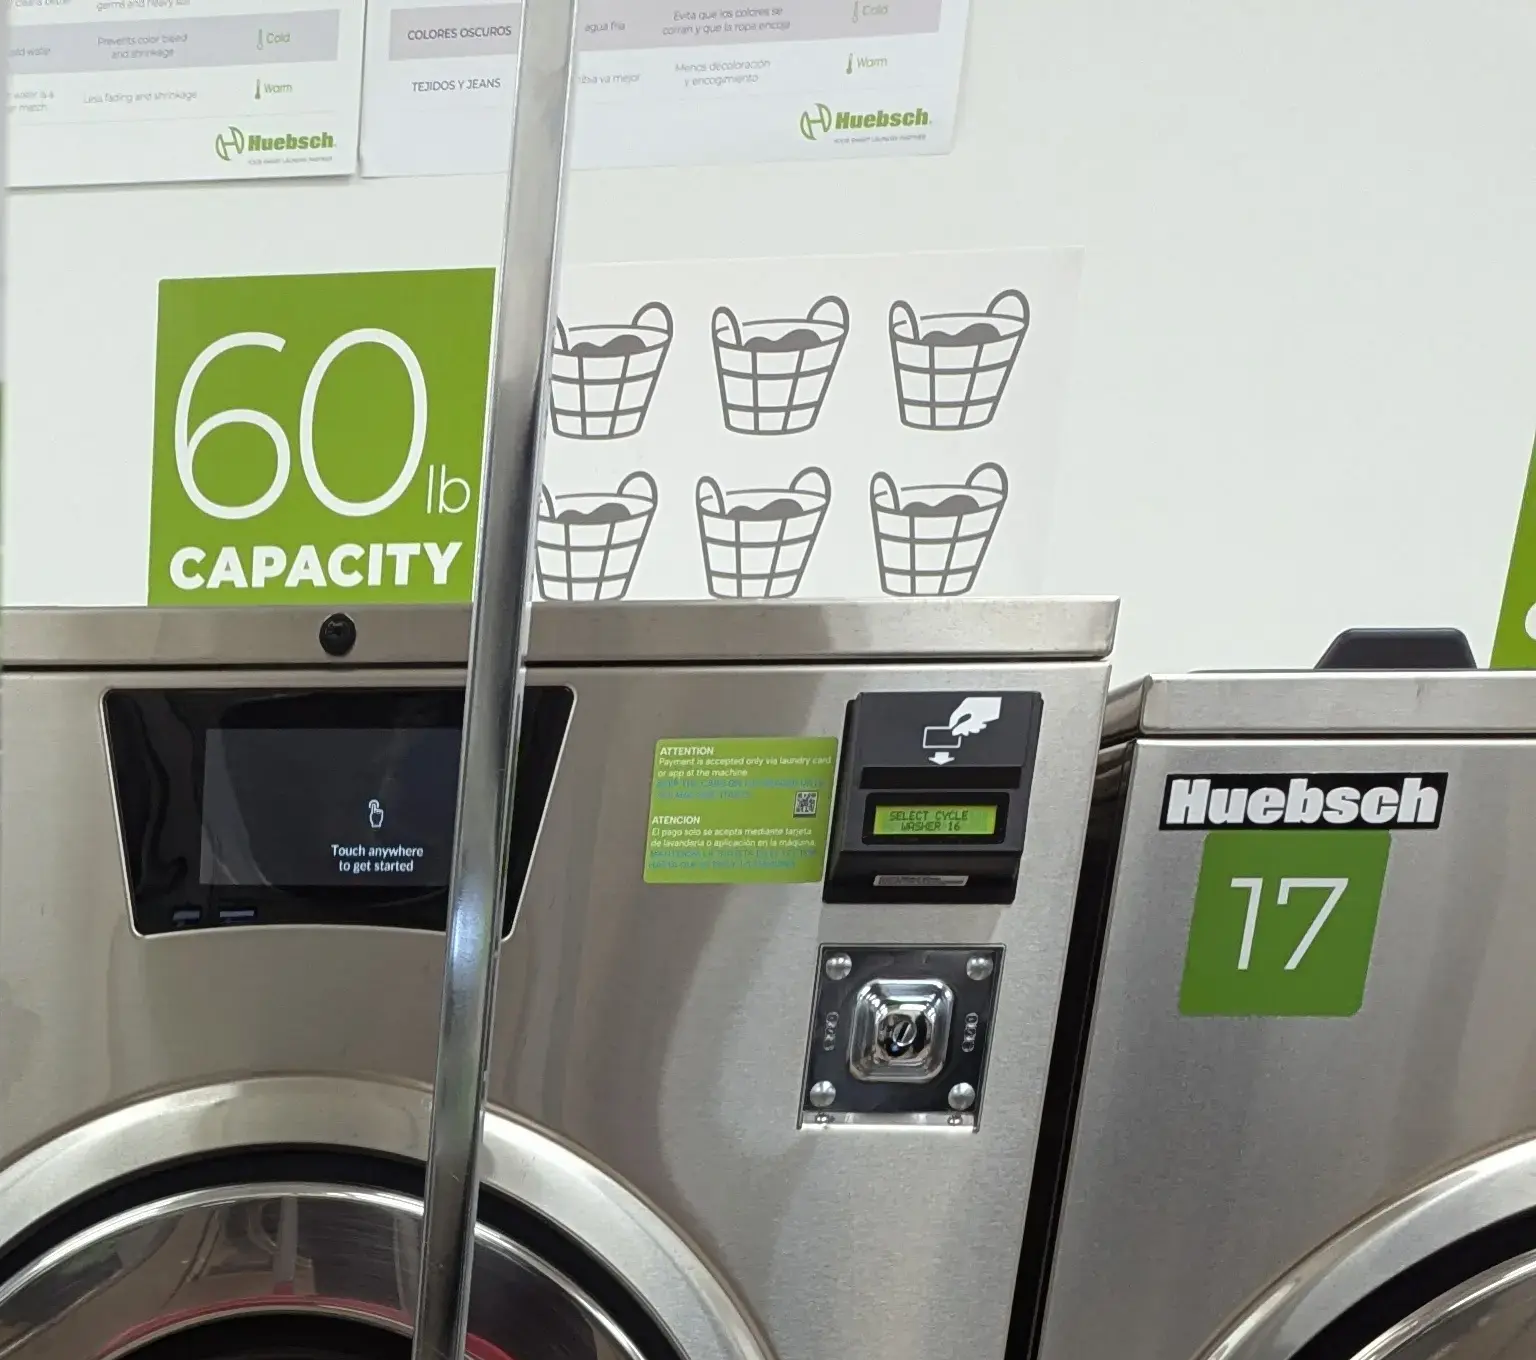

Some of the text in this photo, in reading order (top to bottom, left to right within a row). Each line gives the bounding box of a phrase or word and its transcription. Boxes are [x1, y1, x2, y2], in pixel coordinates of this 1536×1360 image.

[266, 32, 291, 43] Cold
[407, 25, 512, 40] COLORES OSCUROS
[856, 57, 888, 69] Warm
[264, 83, 293, 94] Warm
[412, 78, 501, 92] TEJIDOS Y JEANS
[835, 108, 929, 130] Huebsch
[248, 132, 334, 152] Huebsch
[174, 327, 427, 520] 60
[427, 464, 470, 514] lb
[169, 542, 463, 590] CAPACITY
[660, 747, 714, 756] ATTENTION
[659, 757, 695, 767] Payment
[706, 757, 744, 767] accepted
[746, 757, 764, 766] only
[765, 757, 778, 765] via
[779, 756, 811, 766] laundry
[812, 756, 831, 765] card
[668, 770, 685, 780] app
[686, 769, 695, 777] at
[1166, 777, 1439, 824] Huebsch
[652, 816, 700, 825] ATENCION
[889, 810, 968, 821] SELECT CYCLE
[901, 821, 961, 831] WASHER 16
[652, 828, 660, 836] El
[661, 828, 682, 838] pago
[714, 828, 742, 837] acepta
[744, 828, 783, 836] mediante
[785, 828, 812, 837] tarjeta
[651, 839, 662, 847] de
[331, 844, 424, 859] Touch anywhere
[339, 859, 414, 874] to get started
[1230, 877, 1349, 970] 17
